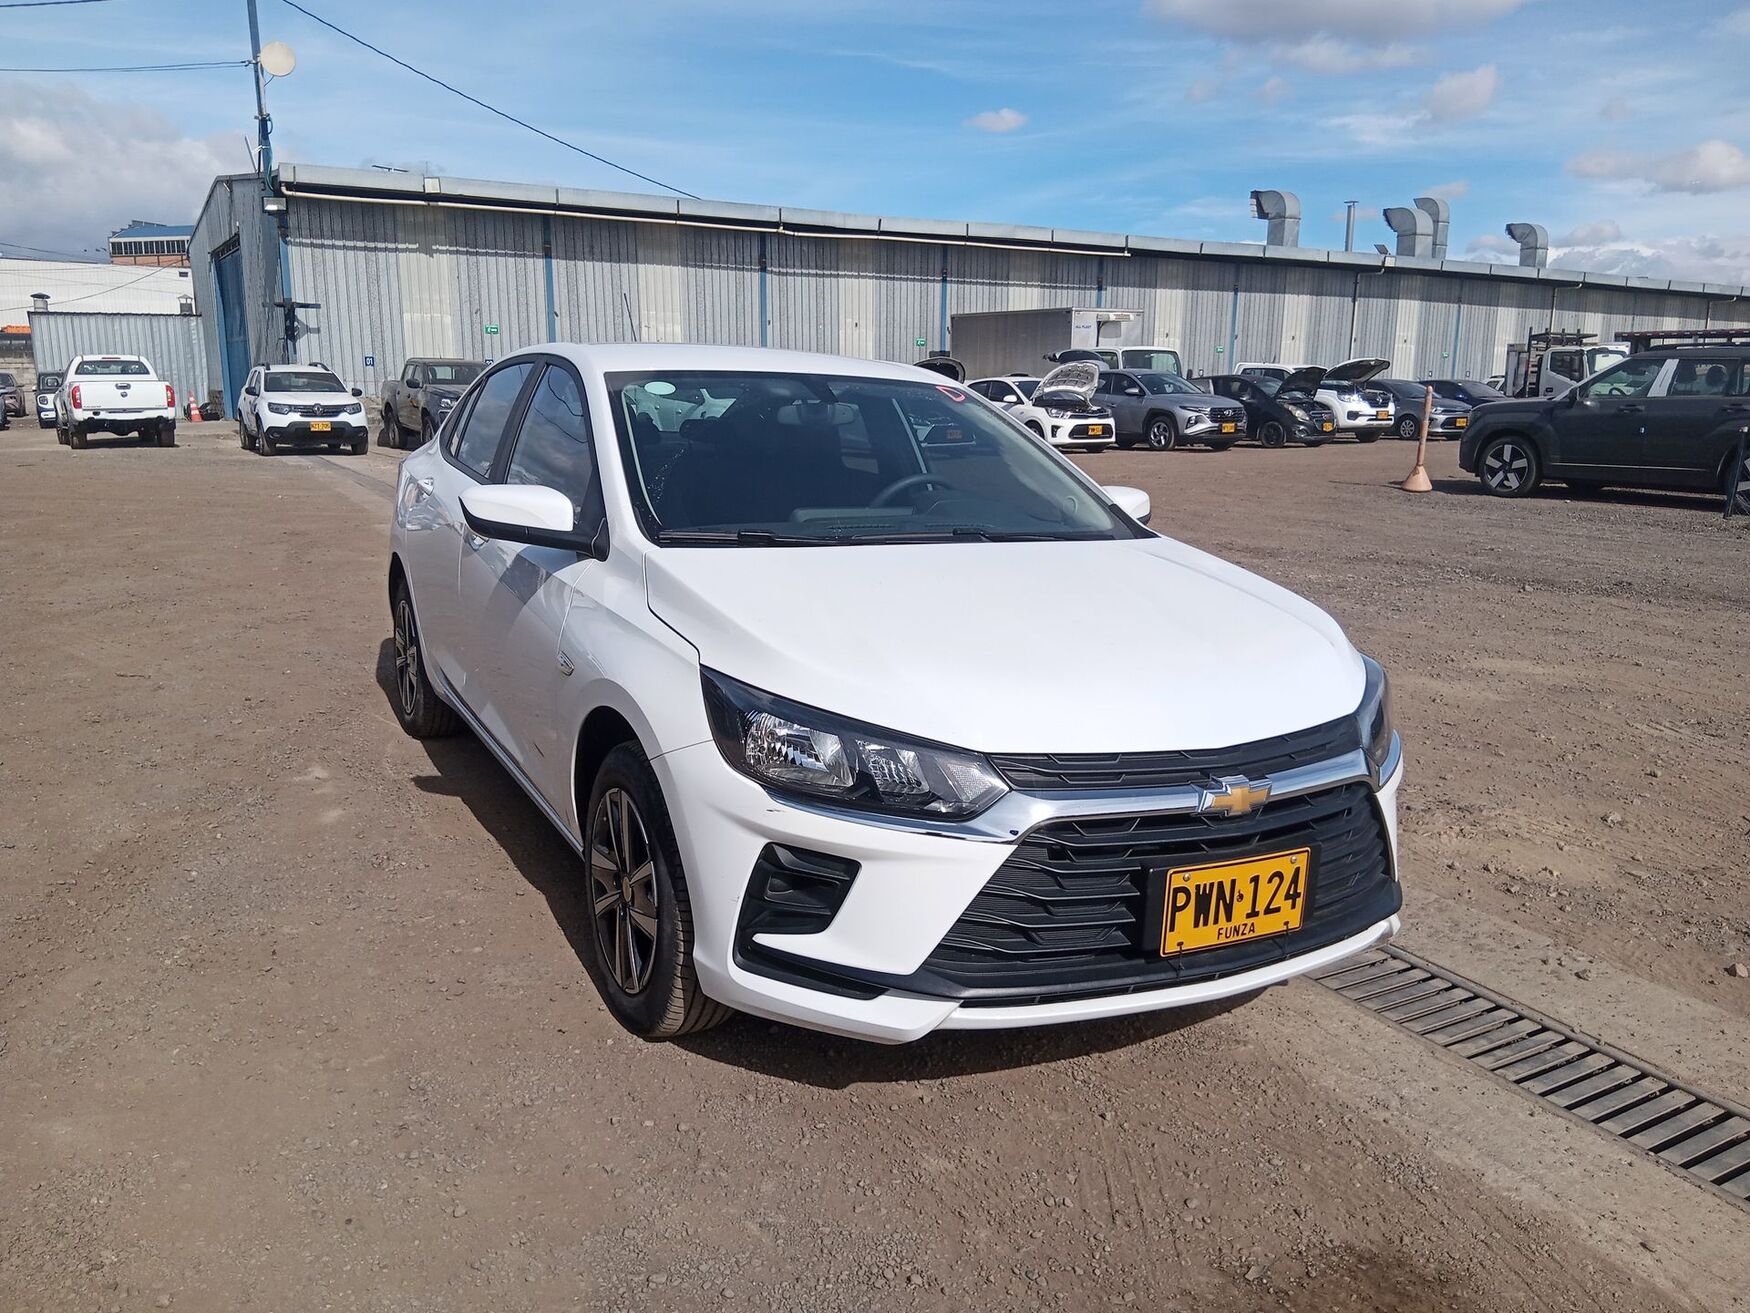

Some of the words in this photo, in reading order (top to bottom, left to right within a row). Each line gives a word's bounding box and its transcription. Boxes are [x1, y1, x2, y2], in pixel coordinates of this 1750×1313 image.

[1169, 878, 1237, 932] PWN
[1245, 866, 1301, 919] 124
[1217, 922, 1255, 940] FUNZA
